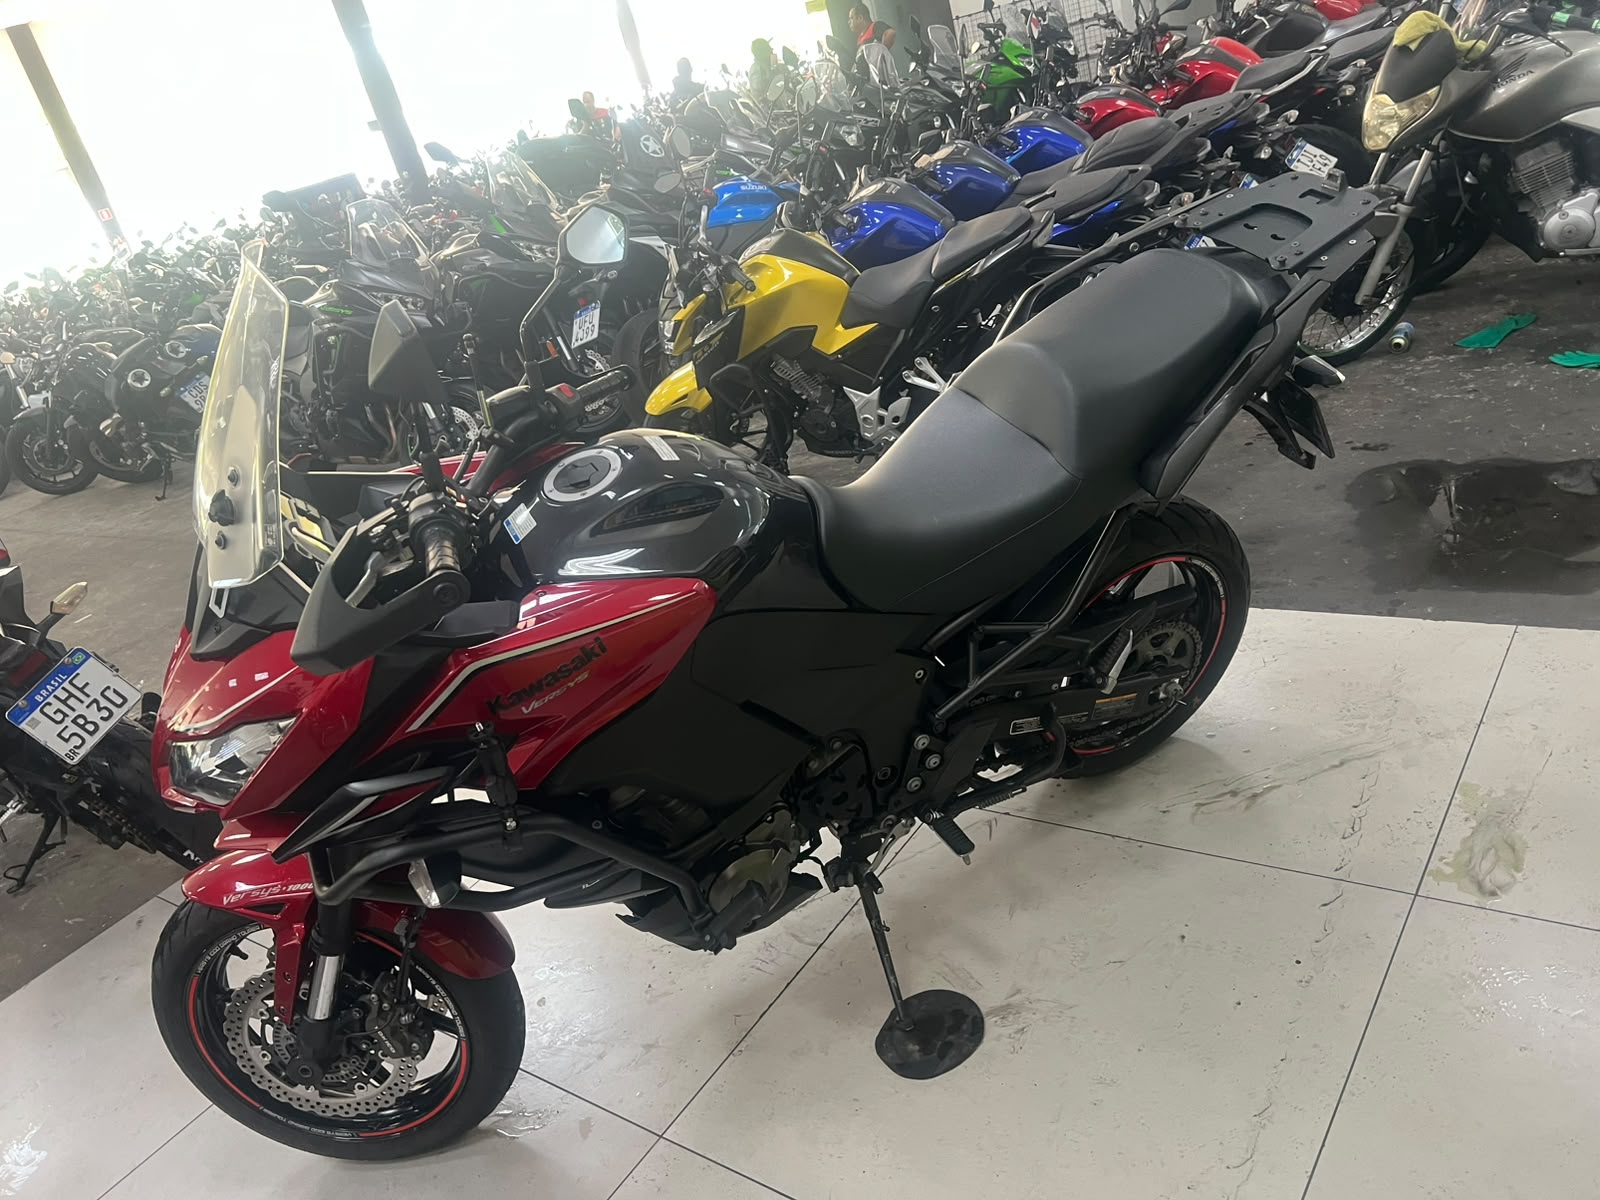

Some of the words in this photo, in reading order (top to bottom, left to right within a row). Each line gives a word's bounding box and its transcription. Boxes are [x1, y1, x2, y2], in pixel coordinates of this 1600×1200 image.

[1492, 69, 1535, 92] HONDA
[34, 673, 68, 703] BRASIL
[486, 636, 608, 715] Kawasaki
[38, 672, 91, 725] GHF
[56, 685, 129, 750] 5B30
[64, 748, 80, 761] BR
